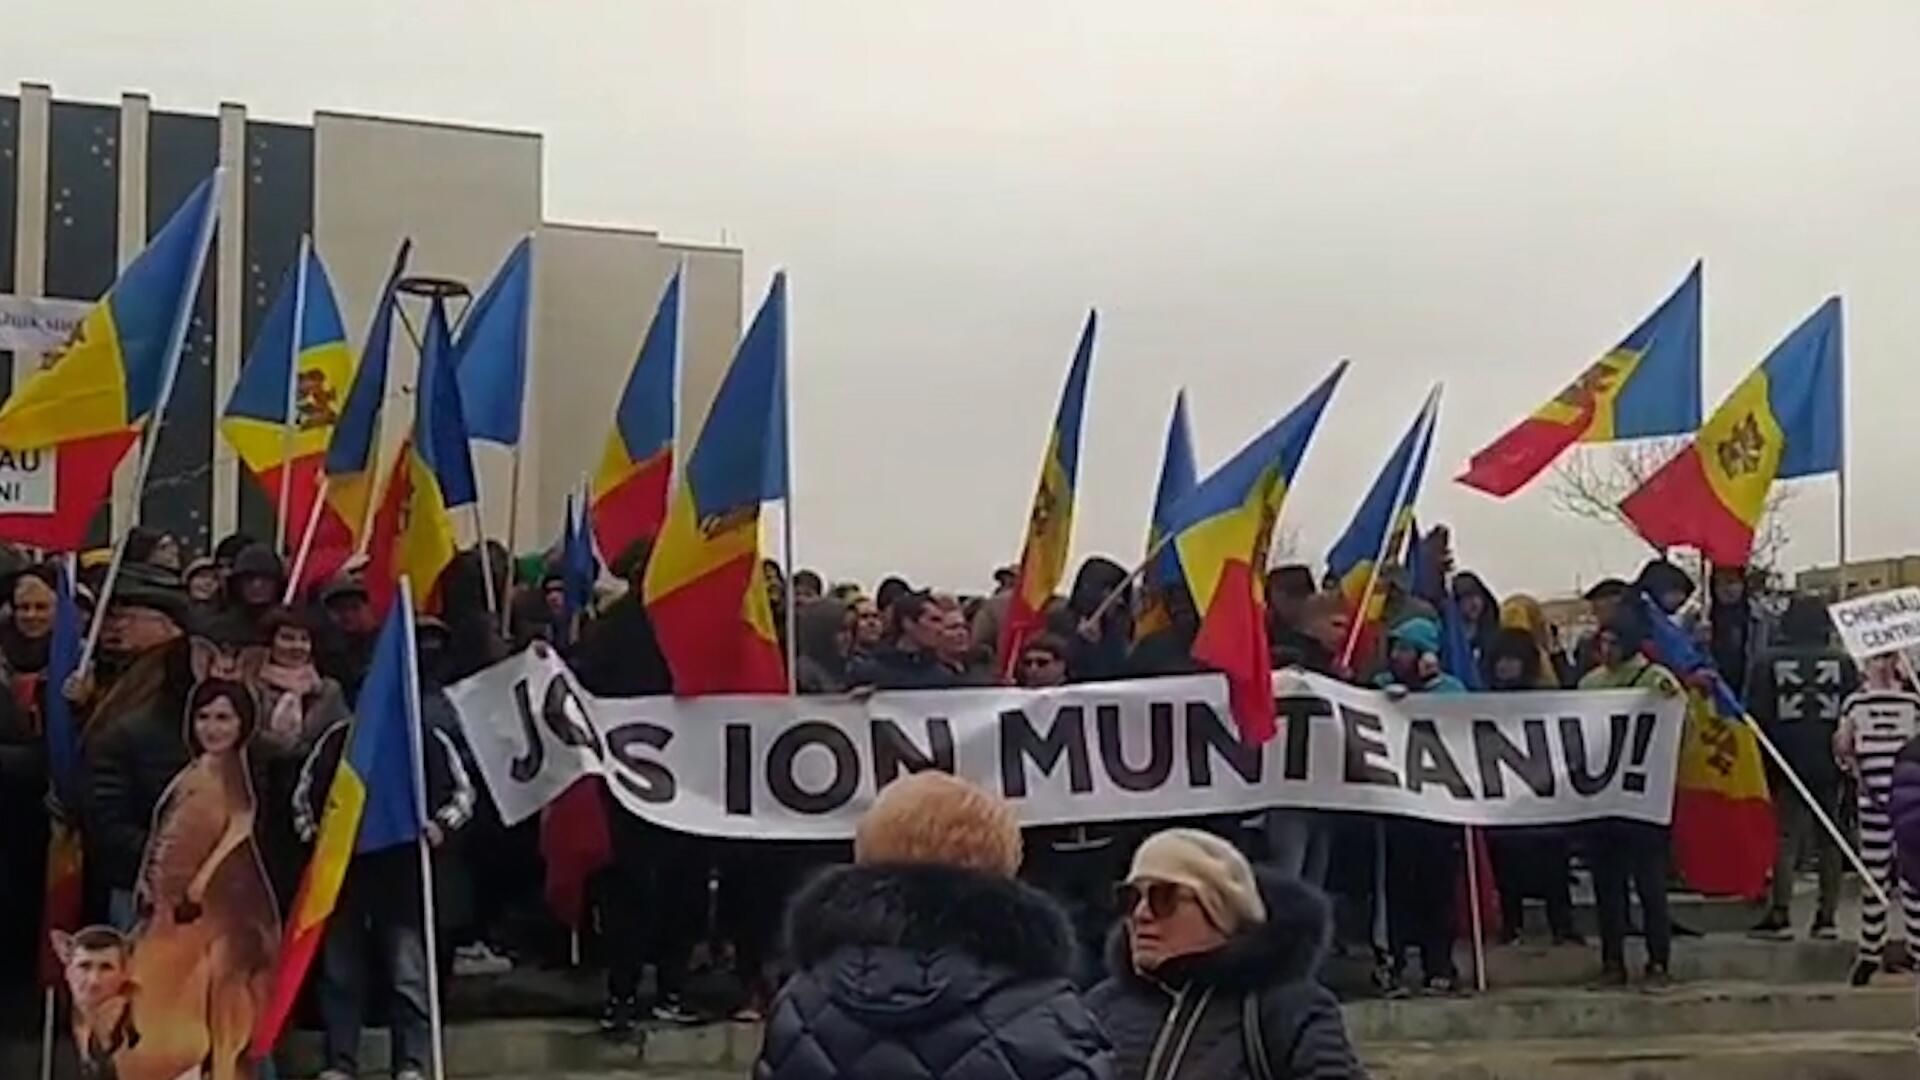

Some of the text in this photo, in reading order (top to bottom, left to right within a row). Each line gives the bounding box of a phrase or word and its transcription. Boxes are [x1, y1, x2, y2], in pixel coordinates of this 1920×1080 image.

[510, 673, 1657, 815] JOS ION MUNTEANU!
